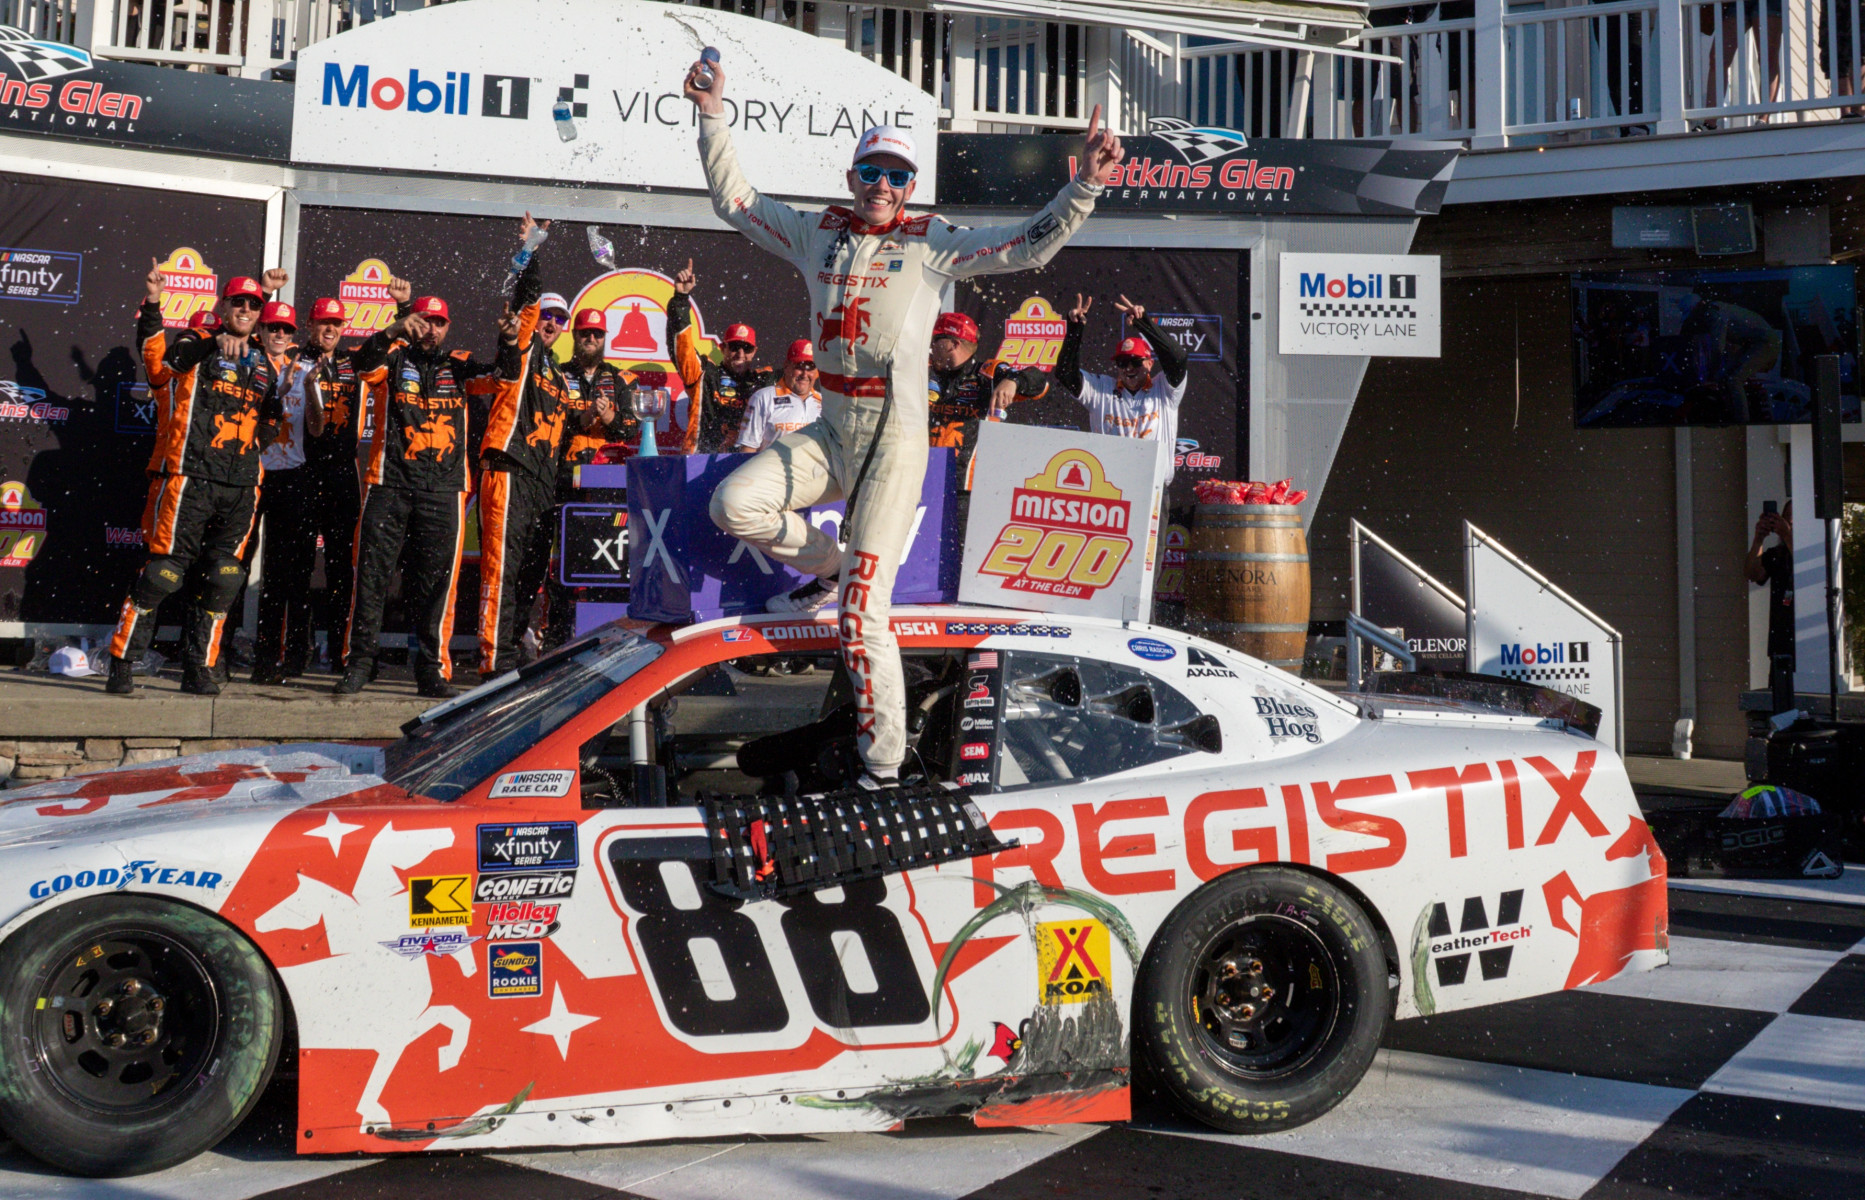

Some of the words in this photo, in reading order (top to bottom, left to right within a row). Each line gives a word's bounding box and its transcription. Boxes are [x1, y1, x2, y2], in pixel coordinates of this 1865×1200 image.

[321, 62, 470, 116] Mobil
[59, 80, 142, 120] Glen
[9, 109, 135, 133] ATIONAL
[808, 104, 914, 139] LANE
[1069, 156, 1212, 189] atkins
[1219, 158, 1295, 189] Glen
[1106, 189, 1291, 202] TERNATIONAL
[12, 253, 51, 265] NASCAR
[817, 272, 890, 288] REGISTIX
[1299, 272, 1382, 299] Mobil
[7, 285, 39, 296] SERIES
[1160, 318, 1194, 327] NASCAR
[1300, 322, 1368, 337] VICTORY
[1374, 322, 1416, 337] LANE
[30, 402, 69, 420] Glen
[1187, 452, 1220, 467] Glen
[982, 524, 1132, 587] 200
[1012, 579, 1029, 589] AT
[1030, 581, 1050, 592] THE
[1052, 582, 1082, 596] GLEN
[1407, 638, 1466, 653] GLENOR
[1500, 642, 1564, 665] Mobil
[1187, 668, 1239, 679] AXALTA
[1251, 696, 1319, 720] Blues
[1264, 717, 1322, 744] Hog
[964, 745, 985, 757] SEM
[519, 773, 563, 783] NASCAR
[502, 785, 532, 794] RACE
[534, 784, 558, 793] CAR
[516, 826, 549, 836] NASCAR
[972, 749, 1611, 908] REGISTIX
[494, 836, 561, 861] xfinity
[514, 856, 542, 865] SERIES
[477, 876, 573, 897] COMETIC
[411, 916, 470, 926] KENNAMETAL
[488, 902, 559, 925] Holley
[486, 923, 548, 940] MSD
[608, 836, 931, 1036] 88
[400, 936, 428, 947] FIVE
[432, 934, 462, 943] STAR
[494, 957, 536, 967] SUNOCO
[493, 976, 538, 987] ROOKIE
[1045, 979, 1102, 997] KOA
